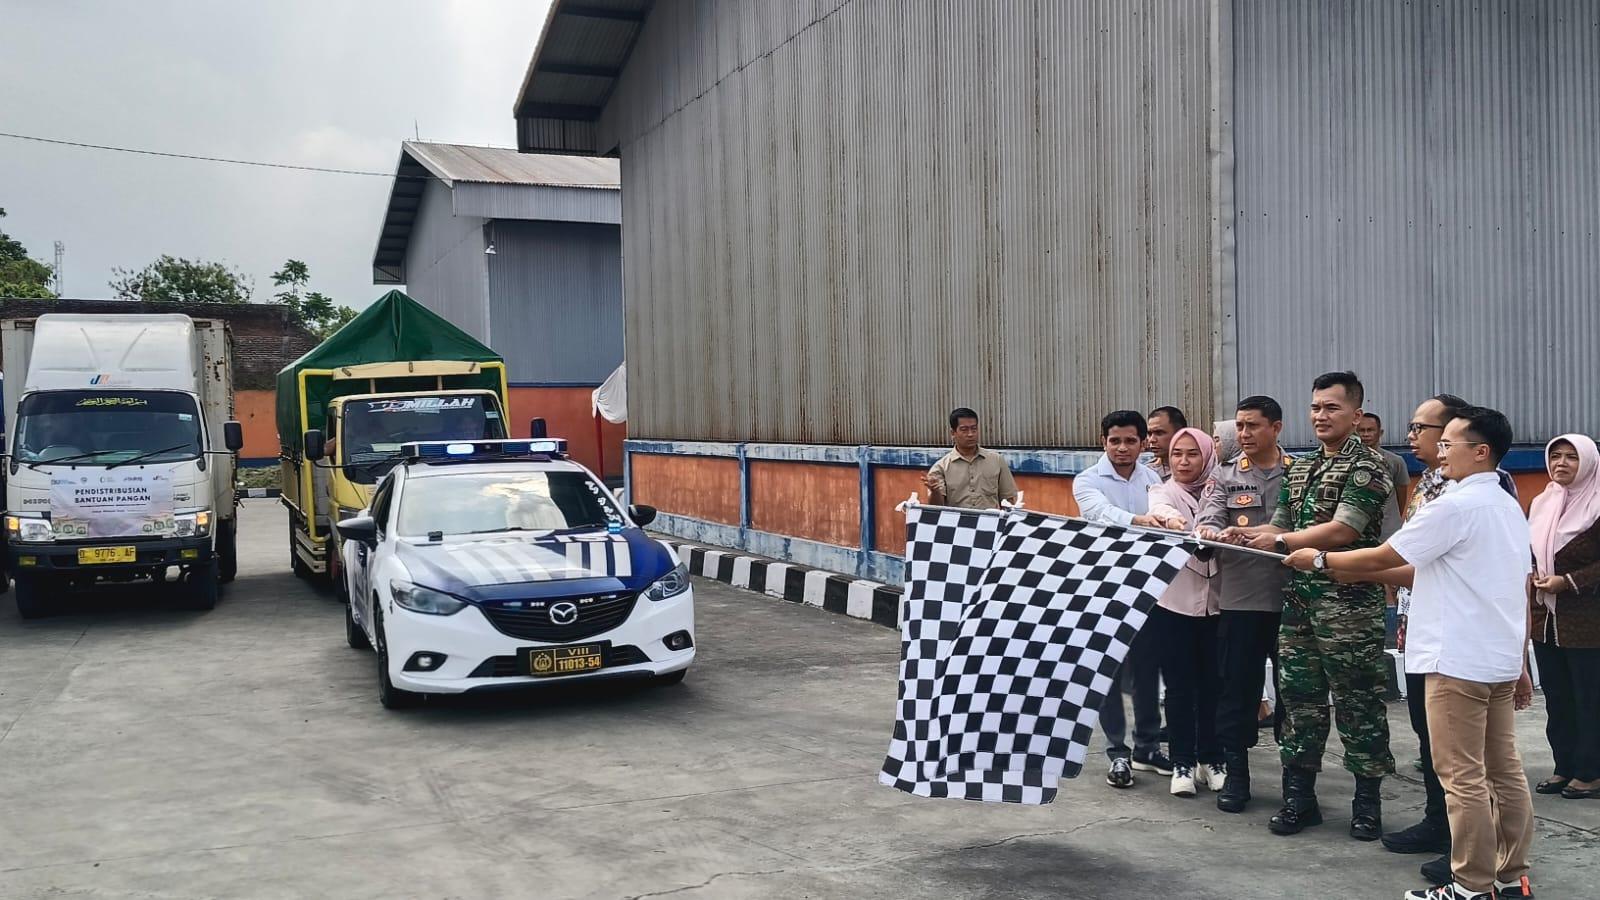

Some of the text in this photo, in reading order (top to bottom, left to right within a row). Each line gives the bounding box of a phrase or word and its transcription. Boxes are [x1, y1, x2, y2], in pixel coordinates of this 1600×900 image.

[75, 487, 147, 496] PENDISTRIBUSIAN
[74, 496, 114, 504] BANTUAN
[94, 548, 116, 558] 9776
[568, 647, 589, 656] VIII
[558, 656, 600, 670] 11013-54
